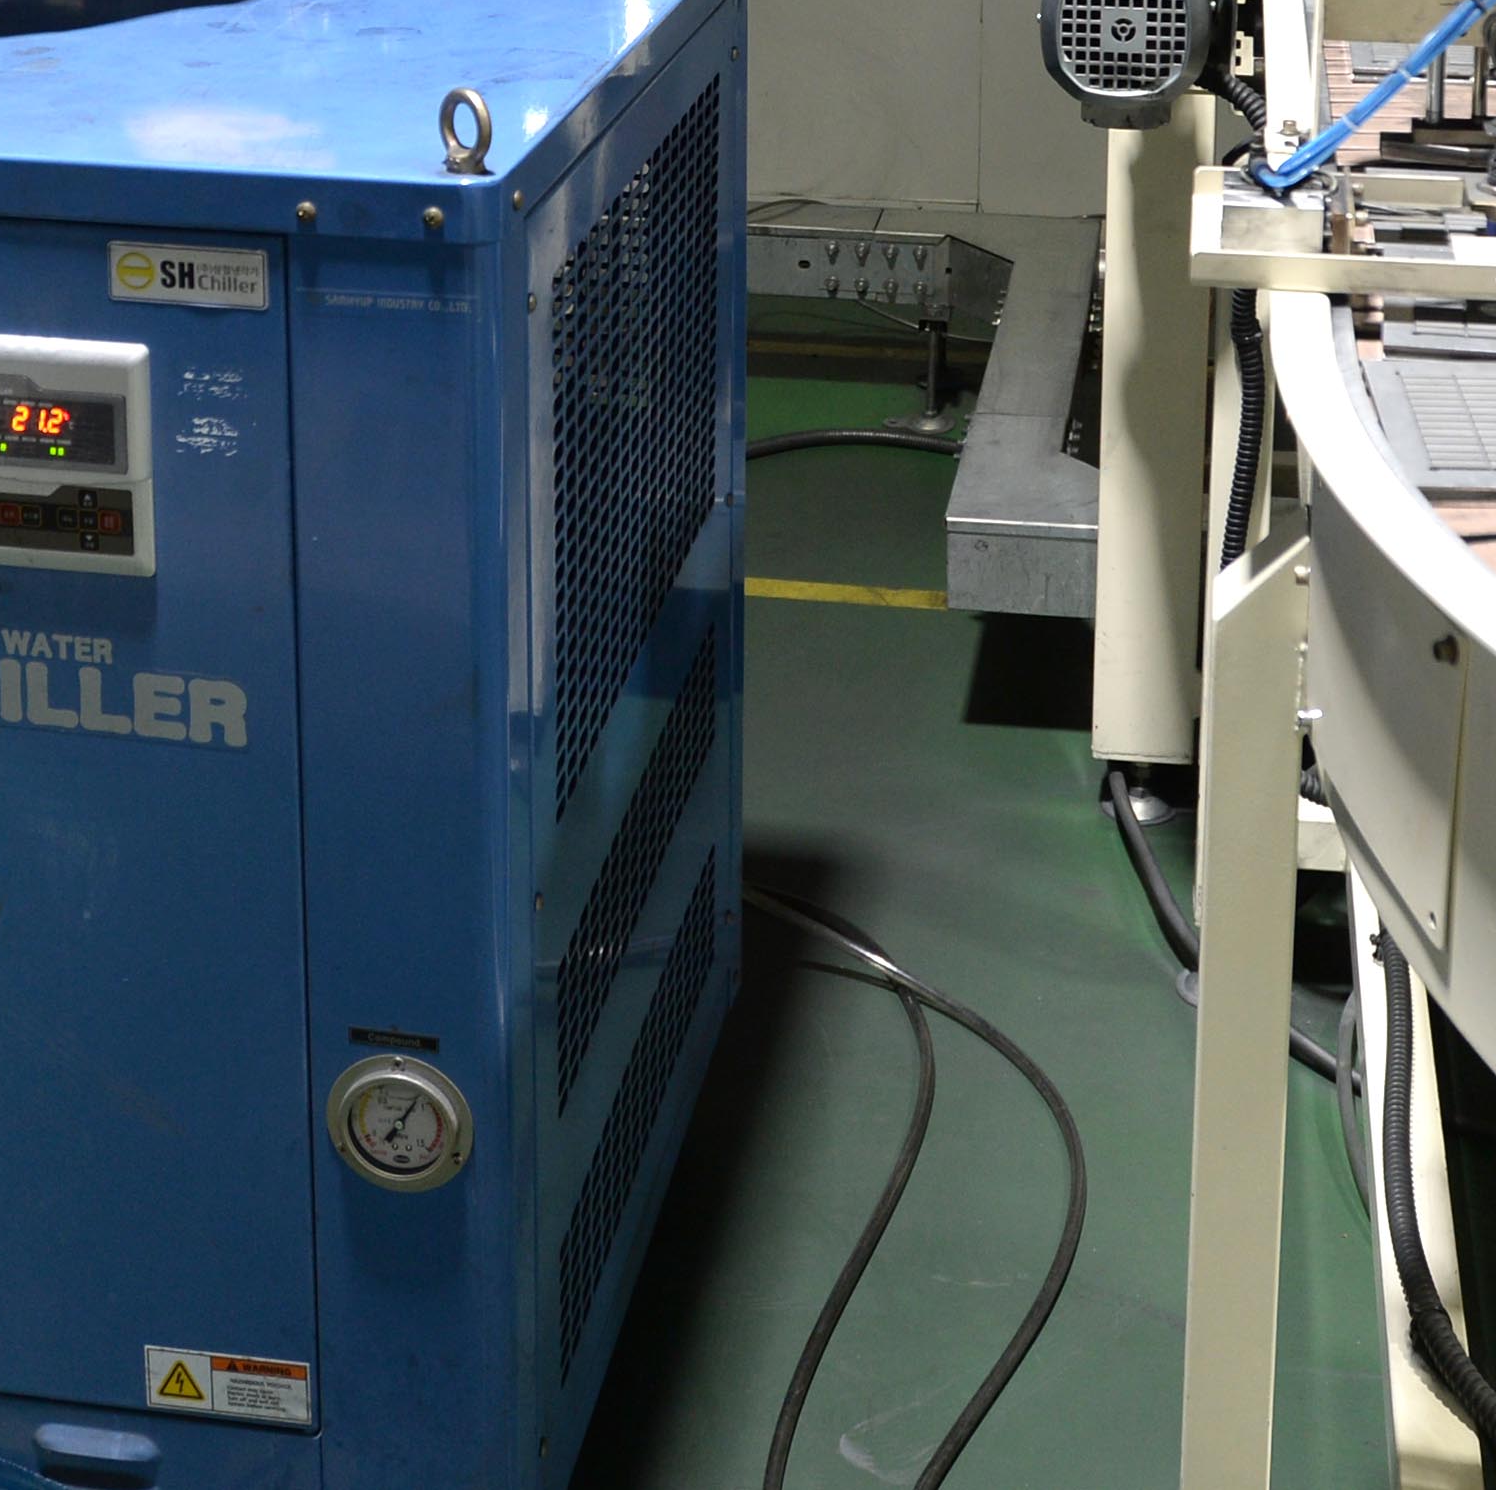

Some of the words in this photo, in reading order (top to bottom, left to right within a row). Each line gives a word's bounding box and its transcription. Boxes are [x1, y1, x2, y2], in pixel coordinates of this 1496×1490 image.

[160, 259, 195, 290] SH
[198, 274, 257, 294] Chiller
[377, 296, 425, 309] INDUSTRY
[11, 404, 65, 435] 21.2
[1, 628, 113, 665] WATER
[243, 1364, 292, 1377] WARNING
